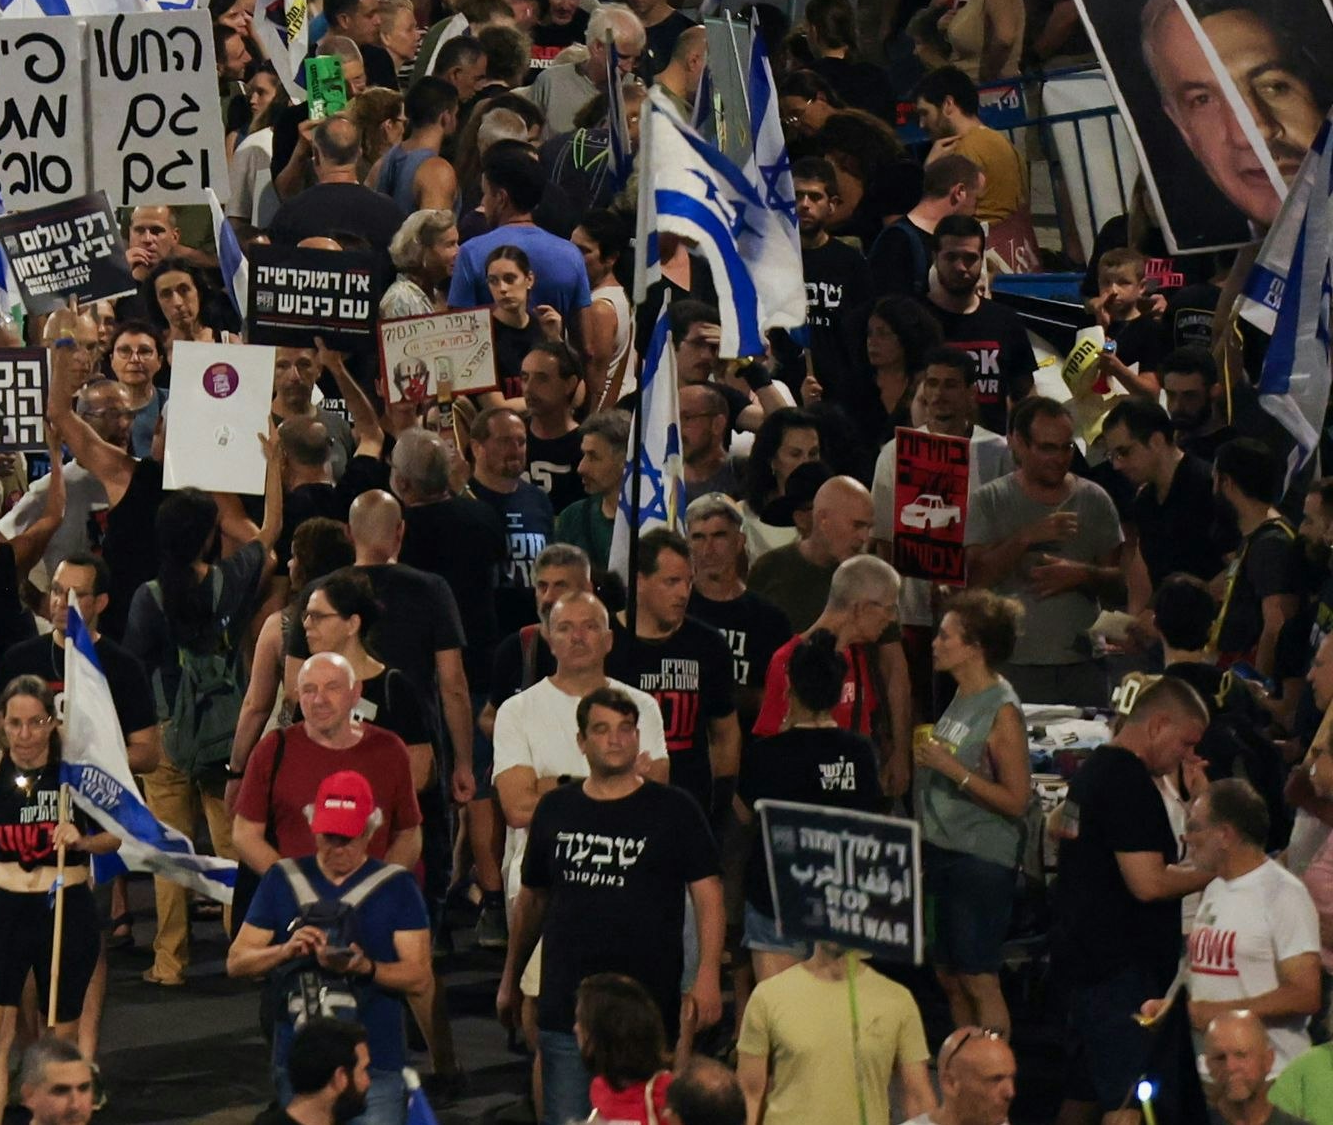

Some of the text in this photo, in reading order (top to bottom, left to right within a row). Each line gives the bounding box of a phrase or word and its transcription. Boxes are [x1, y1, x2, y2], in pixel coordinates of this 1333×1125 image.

[116, 92, 199, 151] גם
[18, 210, 111, 252] רק שלום
[11, 233, 117, 282] יביא ביטחון
[256, 265, 371, 294] אין דמוקרטיה
[277, 291, 371, 320] עם כיבוש
[562, 871, 626, 887] באוקטובר
